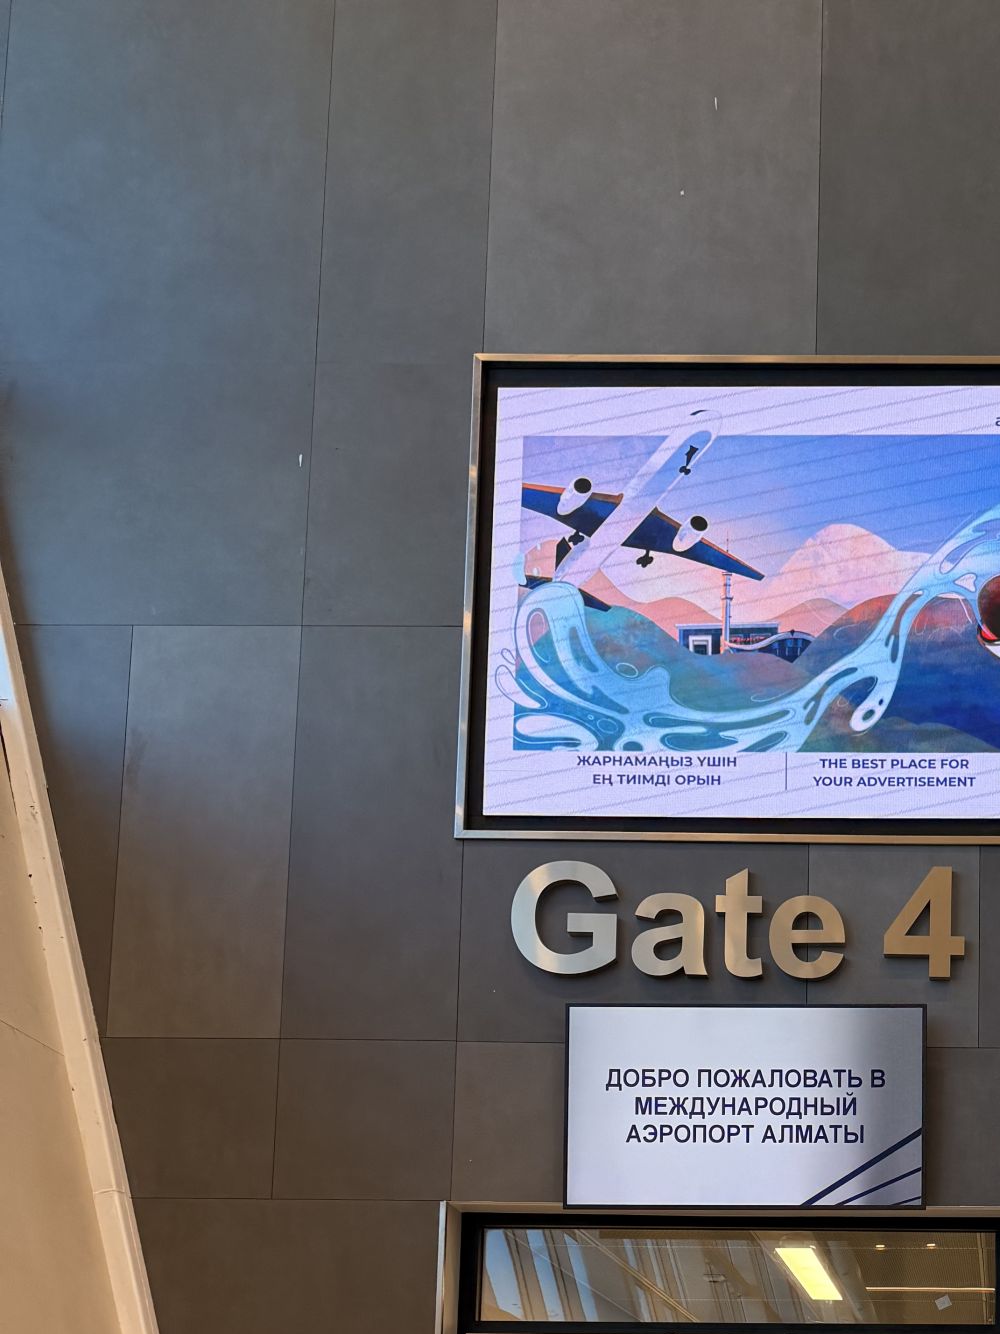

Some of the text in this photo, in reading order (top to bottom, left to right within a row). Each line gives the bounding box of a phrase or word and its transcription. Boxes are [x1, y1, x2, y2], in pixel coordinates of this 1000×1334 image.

[576, 755, 737, 768] ЖАРНАМАҢЫЗ ҮШІН
[819, 758, 970, 769] THE BEST PLACE FOR
[592, 774, 721, 786] ЕҢ ТИІМДІ ОРЫН
[813, 776, 976, 787] YOUR ADVERTISEMENT
[510, 860, 967, 981] Gate 4
[605, 1068, 886, 1091] ДОБРО ПОЖАЛОВАТЬ В
[634, 1091, 857, 1119] МЕЖДУНАРОДНЫЙ
[625, 1124, 865, 1144] АЭРОПОРТ АЛМАТЫ
